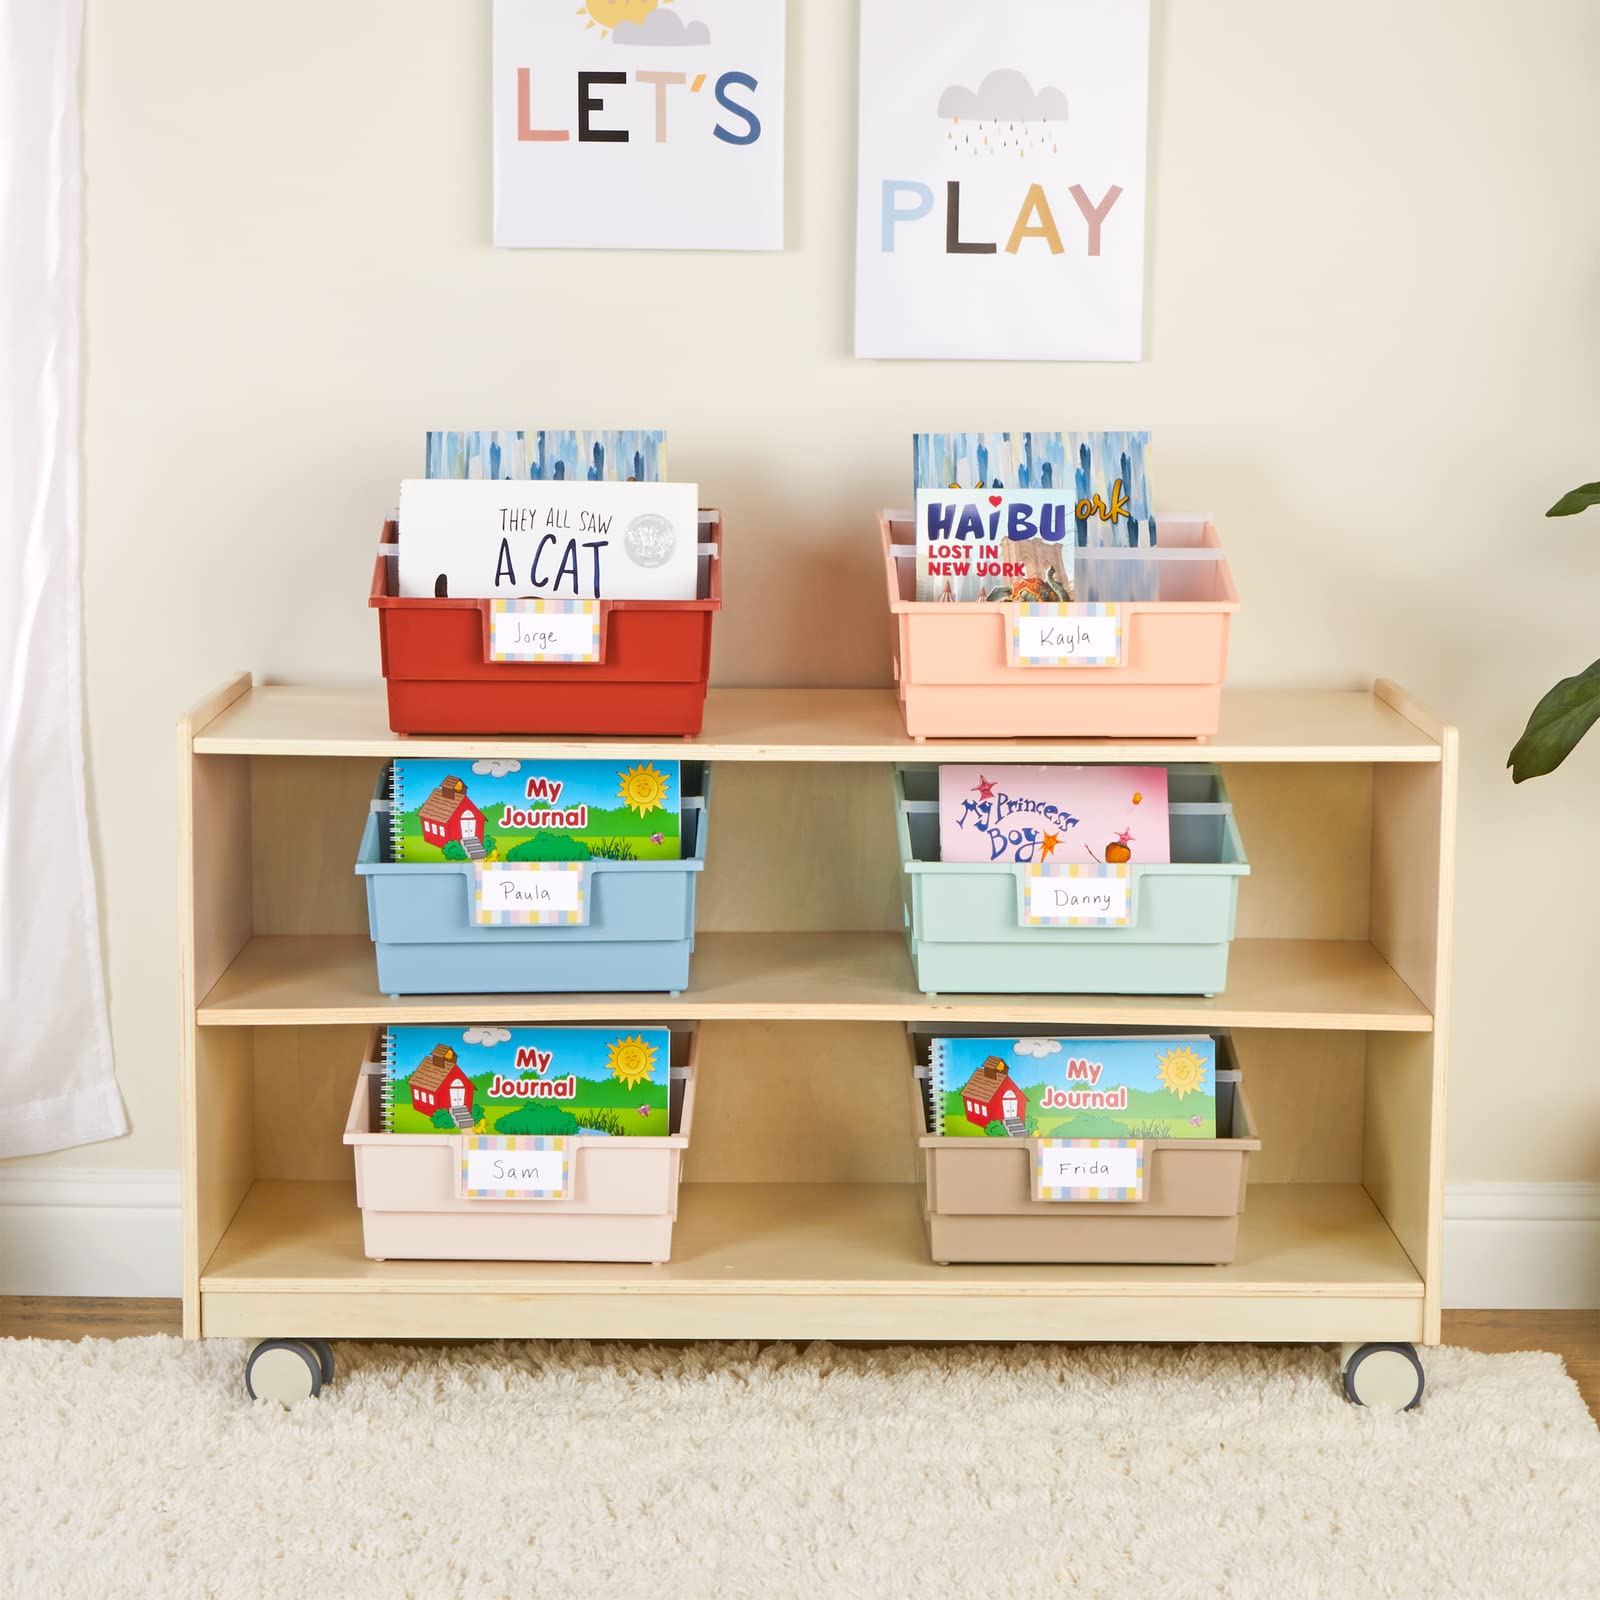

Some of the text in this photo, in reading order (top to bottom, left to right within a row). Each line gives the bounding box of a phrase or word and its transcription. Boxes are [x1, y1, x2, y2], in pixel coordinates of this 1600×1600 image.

[516, 67, 762, 146] LET'S
[880, 179, 1124, 257] PLAY
[1075, 478, 1130, 524] ork
[499, 507, 613, 535] THEY ALL SAW
[928, 543, 999, 559] LOST IN
[494, 537, 516, 587] A
[530, 533, 609, 599] CAT
[928, 561, 1026, 577] NEW YORK
[513, 622, 558, 650] Jorge
[1040, 625, 1091, 654] Kayla
[526, 777, 564, 804] My
[499, 805, 588, 829] Journal
[956, 792, 1080, 832] My Princess
[987, 827, 1046, 863] Boy
[500, 881, 551, 901] Paula
[1054, 889, 1112, 911] Danny
[516, 1048, 553, 1074] My
[1066, 1059, 1103, 1084] My
[489, 1076, 577, 1099] Journal
[1040, 1087, 1128, 1110] Journal
[493, 1160, 540, 1181] Sam
[1059, 1160, 1110, 1176] Frida
